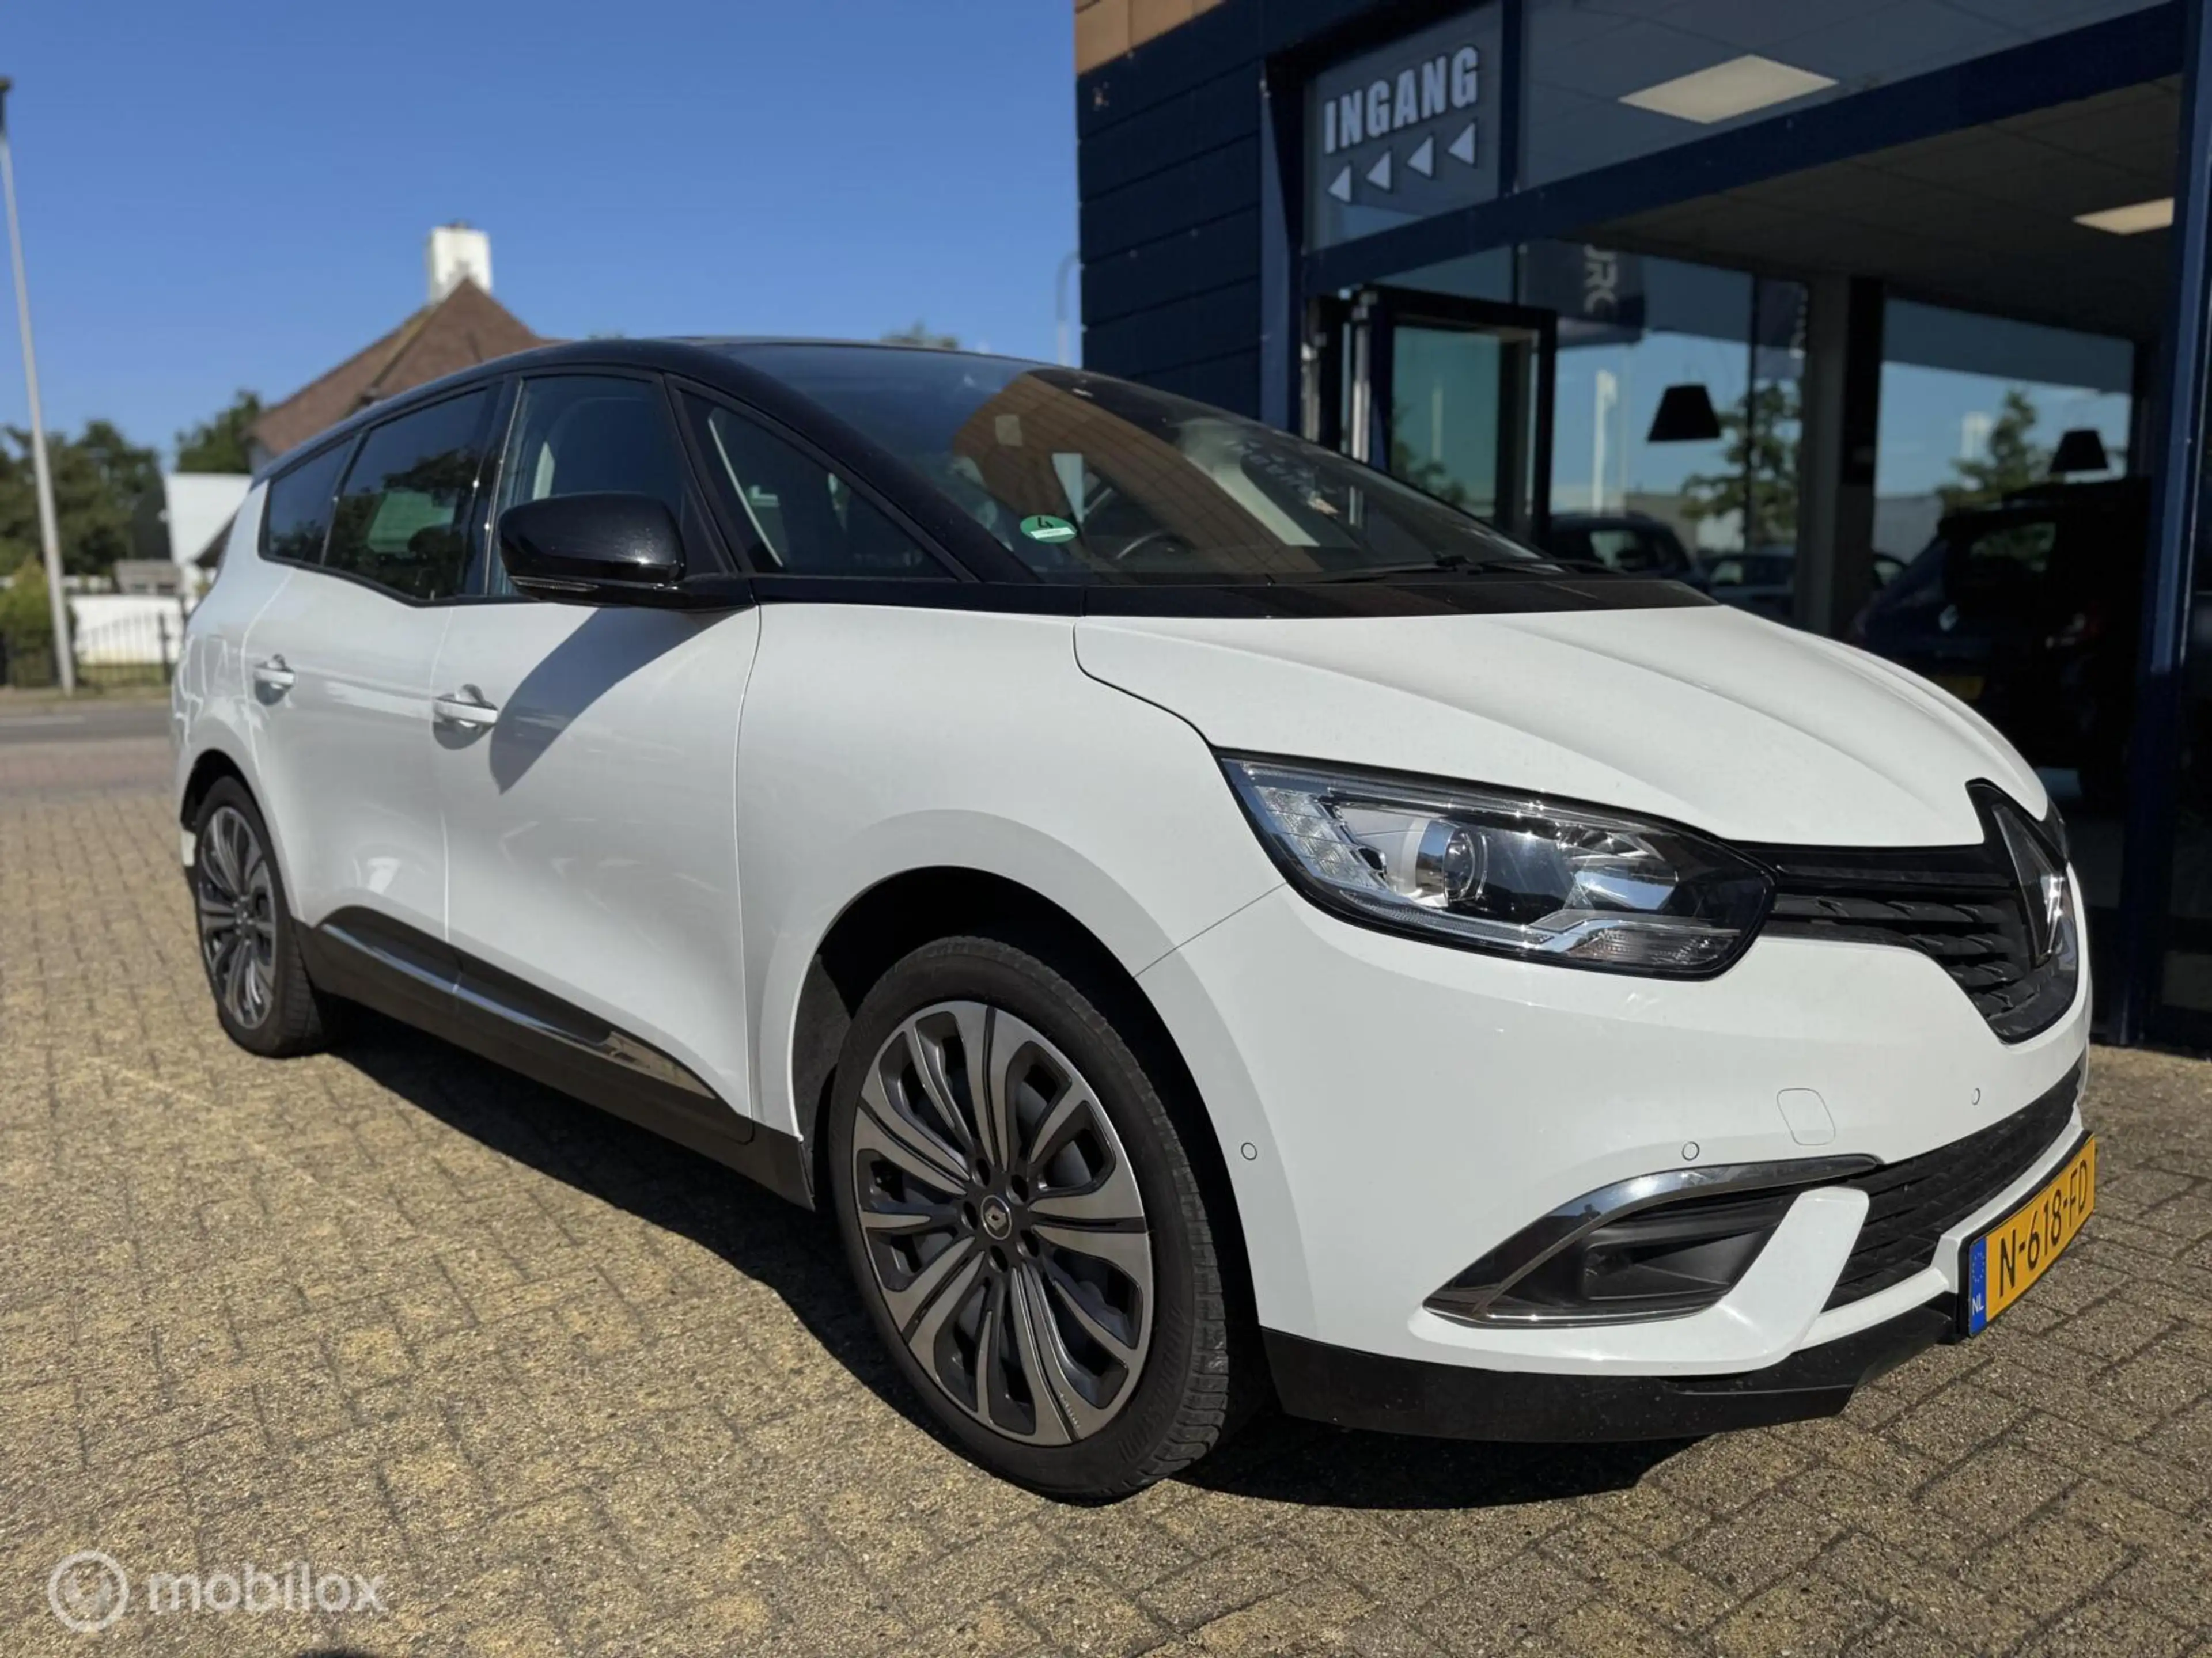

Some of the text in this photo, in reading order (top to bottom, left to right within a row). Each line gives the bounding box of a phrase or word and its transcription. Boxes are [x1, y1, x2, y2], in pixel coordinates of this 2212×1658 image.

[1324, 47, 1479, 154] INGANG
[1999, 1159, 2087, 1297] N-618-FD
[1972, 1293, 1984, 1315] NL
